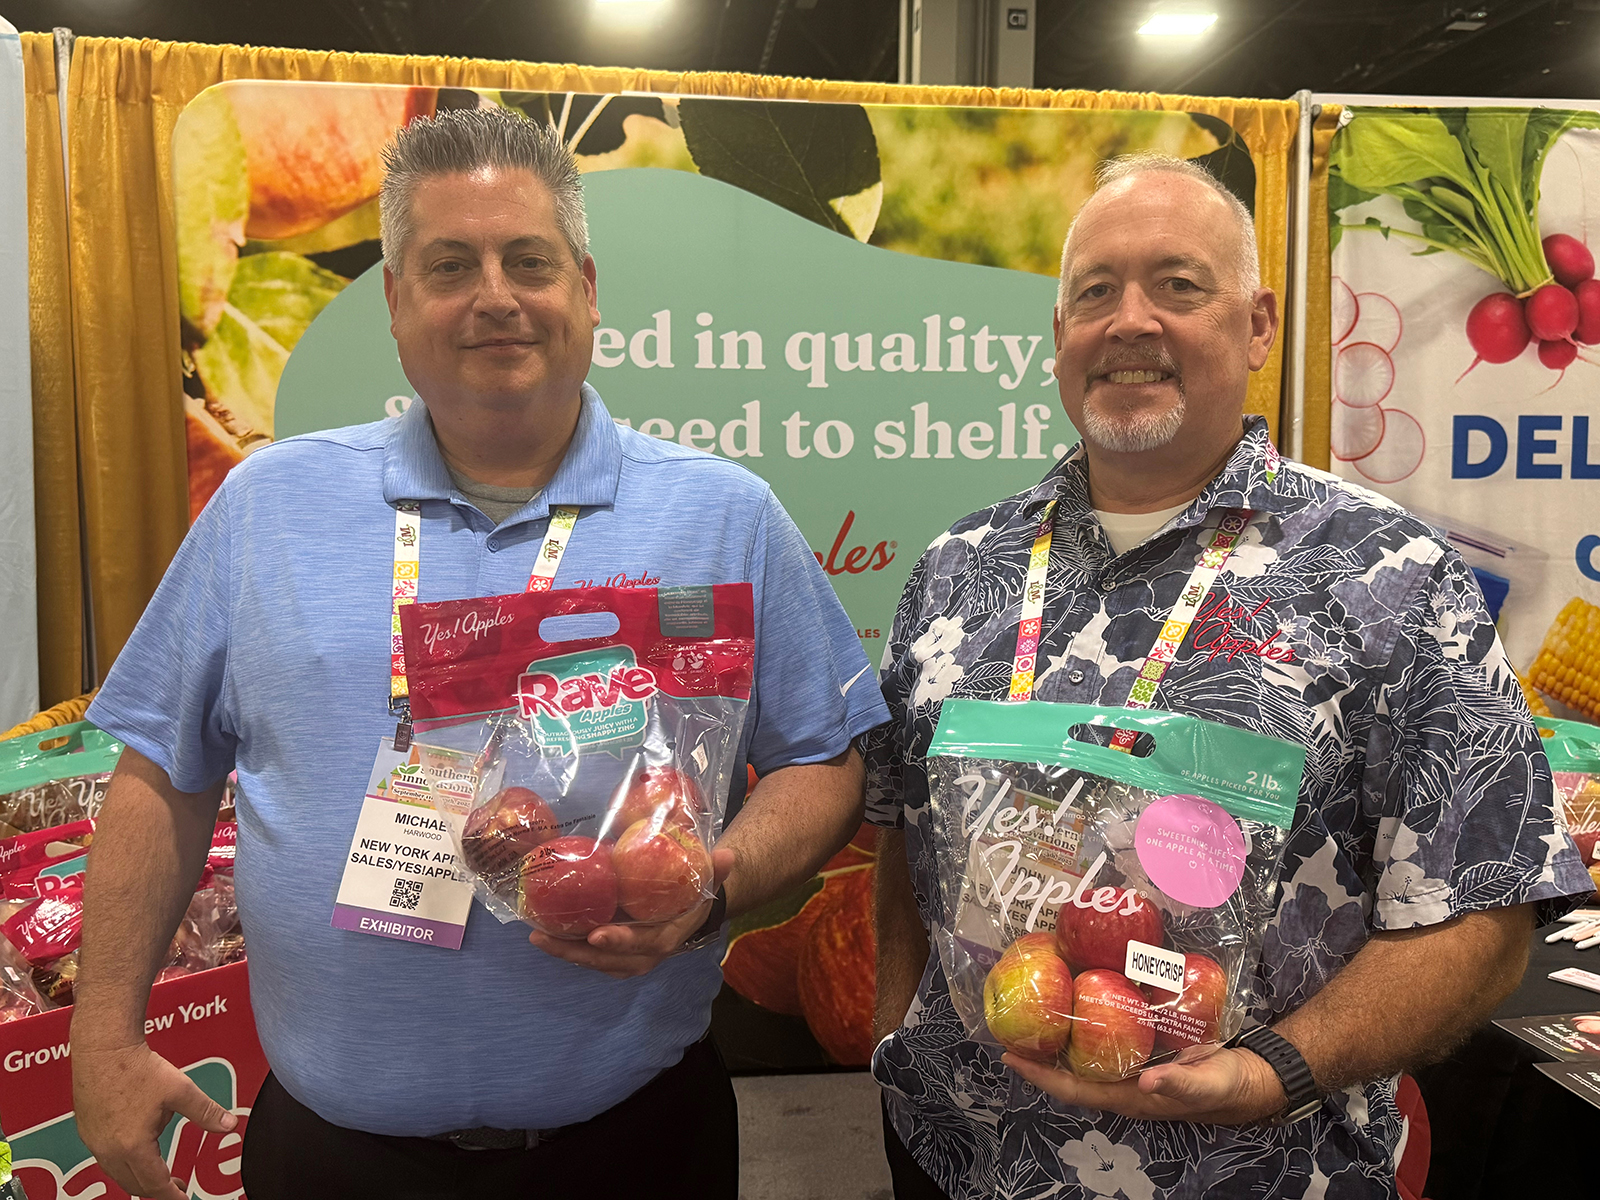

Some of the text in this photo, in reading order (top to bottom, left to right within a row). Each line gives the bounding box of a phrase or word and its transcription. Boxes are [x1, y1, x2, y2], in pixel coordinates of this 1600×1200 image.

[591, 310, 1056, 390] ed in quality,
[781, 411, 855, 459] to
[874, 402, 1068, 460] shelf.
[814, 510, 896, 576] les
[1194, 592, 1271, 634] Yes!
[420, 606, 515, 655] Yes! Apples
[857, 629, 881, 639] LES
[1193, 621, 1298, 663] Apples
[519, 666, 657, 719] Rave
[545, 727, 592, 738] OUTRAGOUSLY
[593, 722, 614, 732] JUICY
[615, 718, 632, 727] WITH
[580, 703, 633, 724] Apples
[546, 724, 635, 742] REFRESNG SNAPPY ZING
[1192, 772, 1219, 785] APPLES
[1221, 780, 1246, 792] PICKED
[1248, 787, 1263, 796] FOR
[1265, 791, 1280, 800] YOU
[1245, 771, 1282, 791] 2 lb.
[953, 775, 1085, 843] Yes!
[360, 838, 456, 865] NEW YORK APP
[403, 828, 442, 841] HARWOOD
[1156, 828, 1227, 859] SWEETENING LIFE
[1146, 837, 1163, 848] ONE
[1166, 843, 1194, 855] APPLE
[1215, 861, 1234, 873] TIME
[978, 841, 1144, 933] Apples
[359, 917, 434, 941] EXHIBITOR
[1132, 951, 1184, 983] HONEYCRISP
[1112, 993, 1126, 1002] NET
[1079, 994, 1103, 1005] MEETS
[1104, 1000, 1115, 1008] OR
[1116, 1002, 1147, 1017] EXCEEDS
[1161, 1016, 1182, 1029] EXTRA
[1183, 1024, 1205, 1036] FANCY
[3, 995, 228, 1073] Grow ew York
